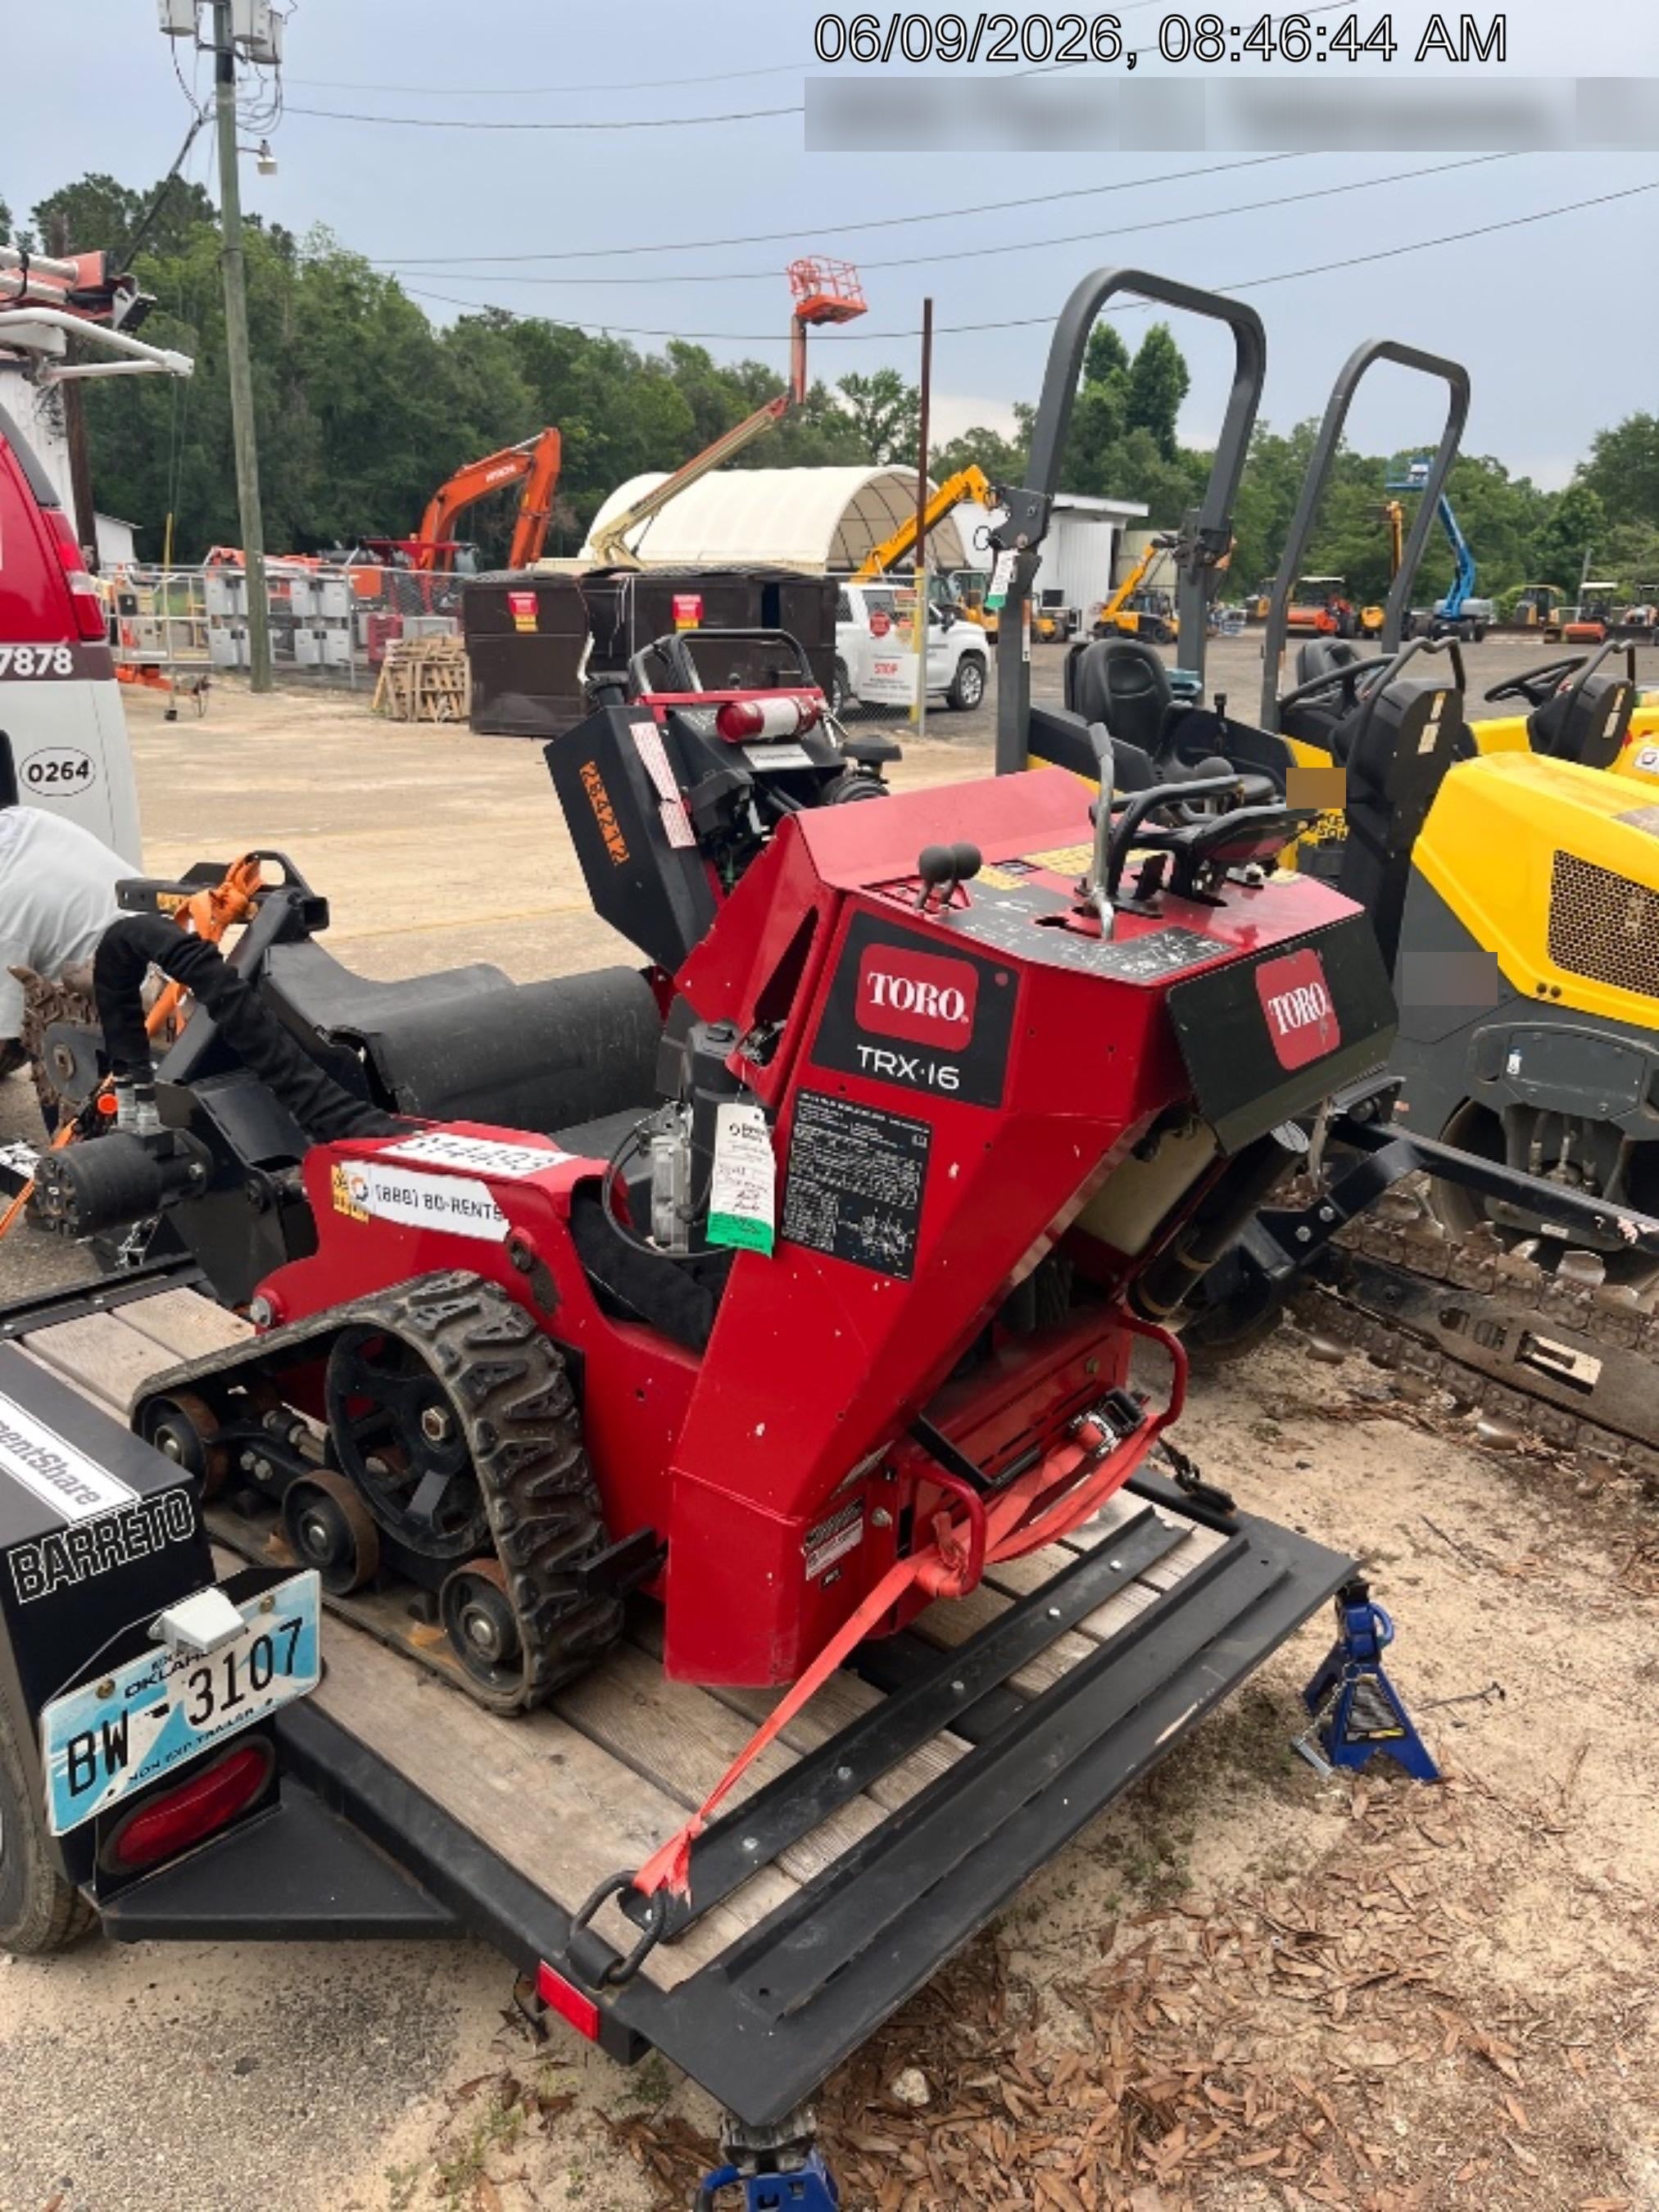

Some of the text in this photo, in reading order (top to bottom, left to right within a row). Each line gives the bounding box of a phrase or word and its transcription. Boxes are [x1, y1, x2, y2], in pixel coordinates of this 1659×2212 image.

[28, 759, 89, 783] 0264
[866, 971, 966, 1022] TORO
[1267, 981, 1327, 1036] TORO
[7, 1489, 195, 1605] BARRETO
[67, 1616, 303, 1797] BW 3107
